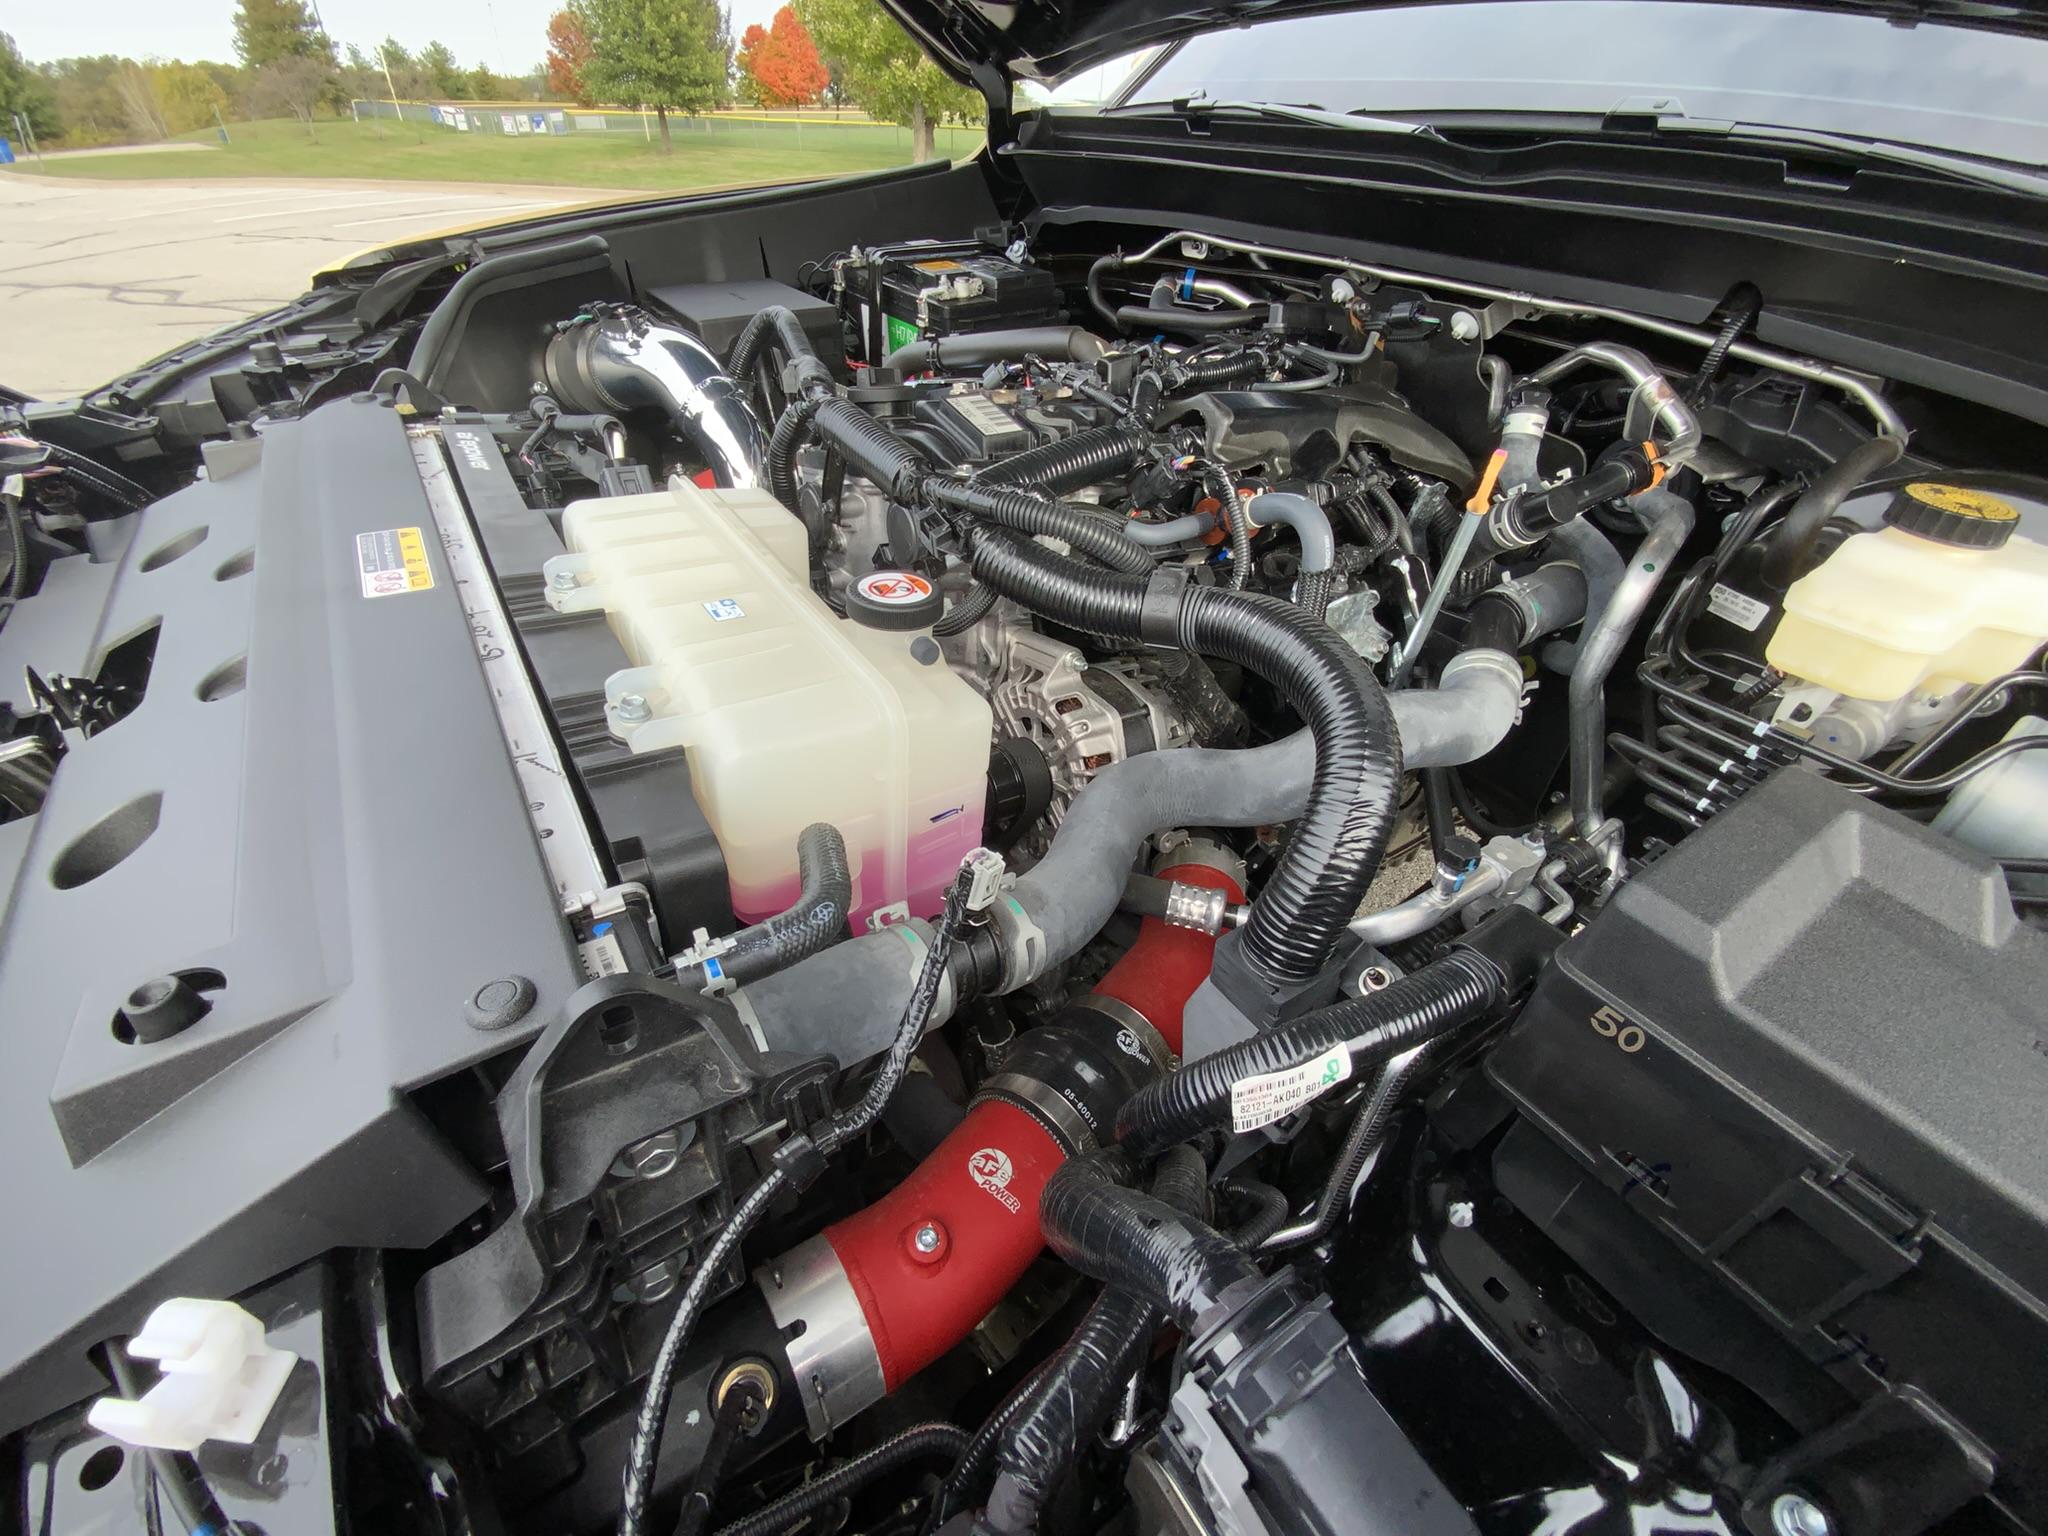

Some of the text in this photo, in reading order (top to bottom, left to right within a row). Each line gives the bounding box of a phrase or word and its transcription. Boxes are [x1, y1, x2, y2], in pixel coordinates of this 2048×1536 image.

[1590, 1005, 1646, 1053] 50
[1064, 1088, 1098, 1130] 05-60012
[1240, 1087, 1302, 1114] 82121-AK040
[979, 1178, 1021, 1214] POWER
